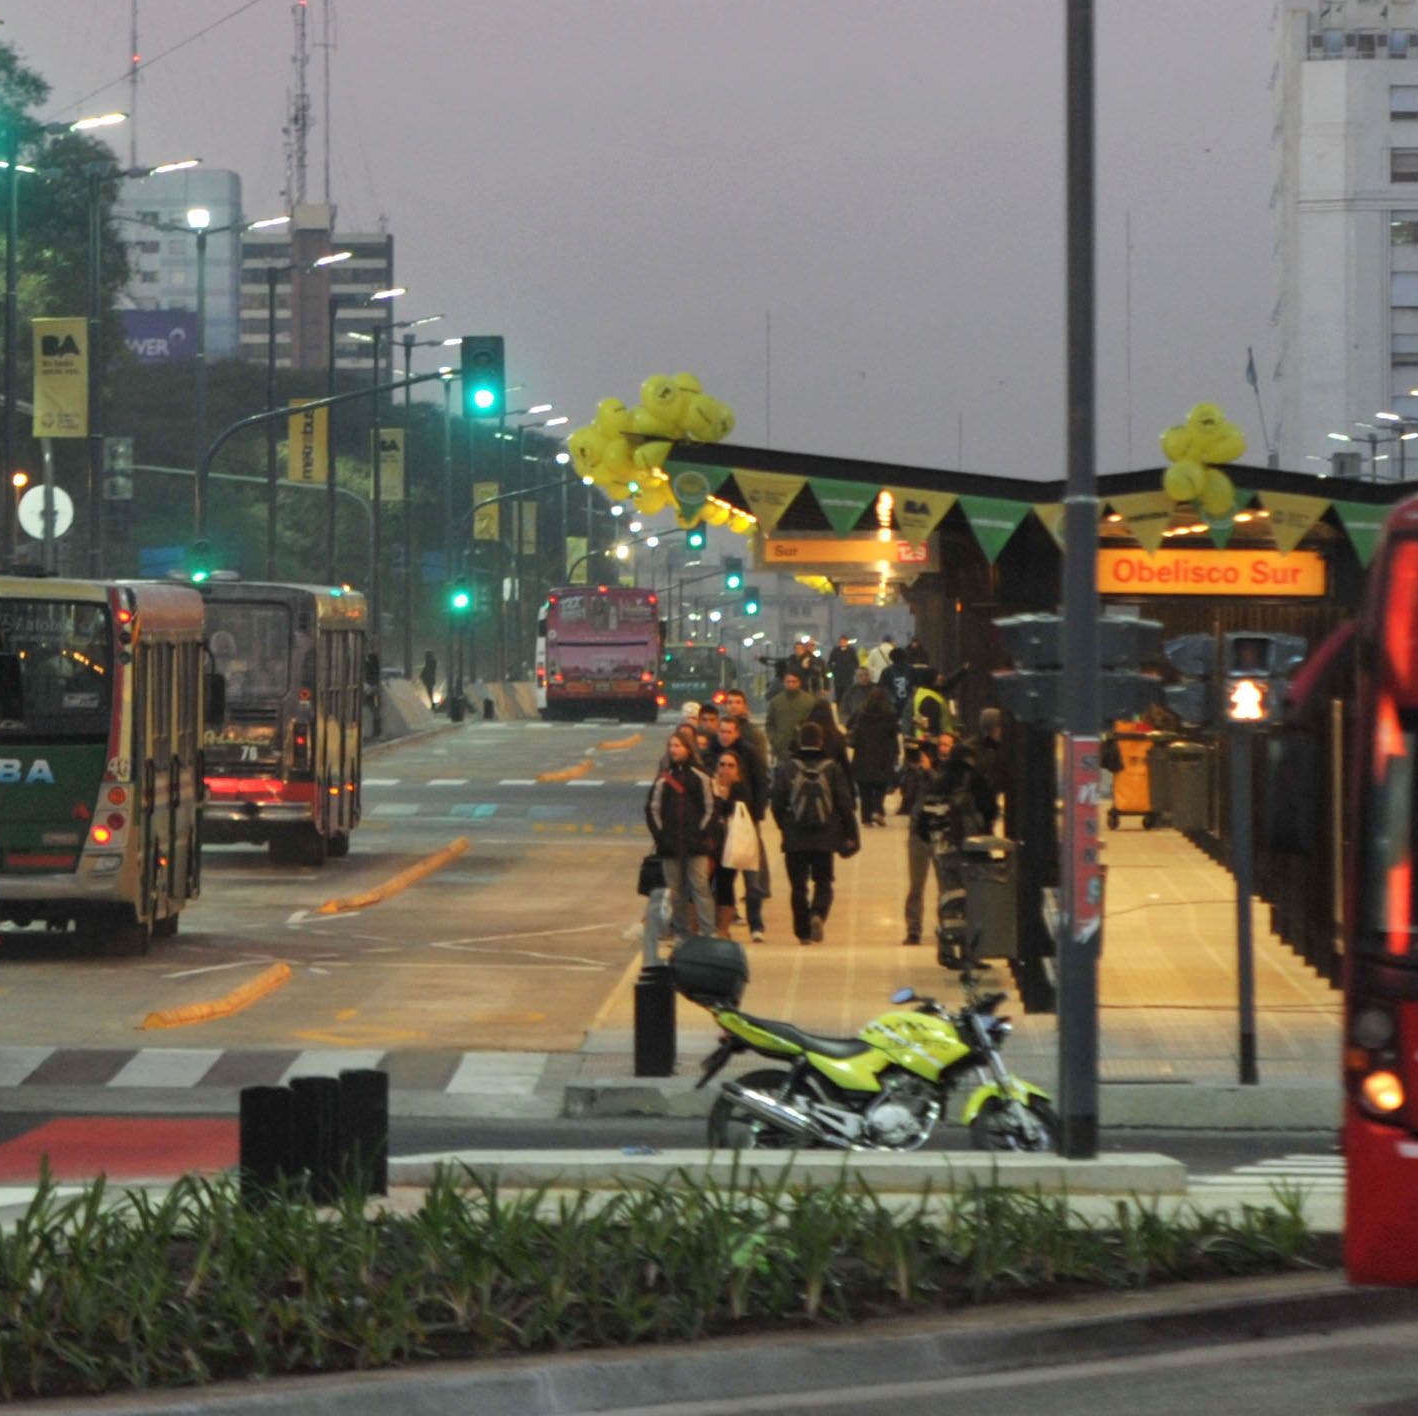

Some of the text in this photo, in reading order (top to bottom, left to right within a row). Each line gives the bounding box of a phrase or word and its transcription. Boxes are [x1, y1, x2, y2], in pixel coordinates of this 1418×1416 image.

[774, 544, 798, 557] Sur
[1113, 558, 1302, 585] Obelisco Sur
